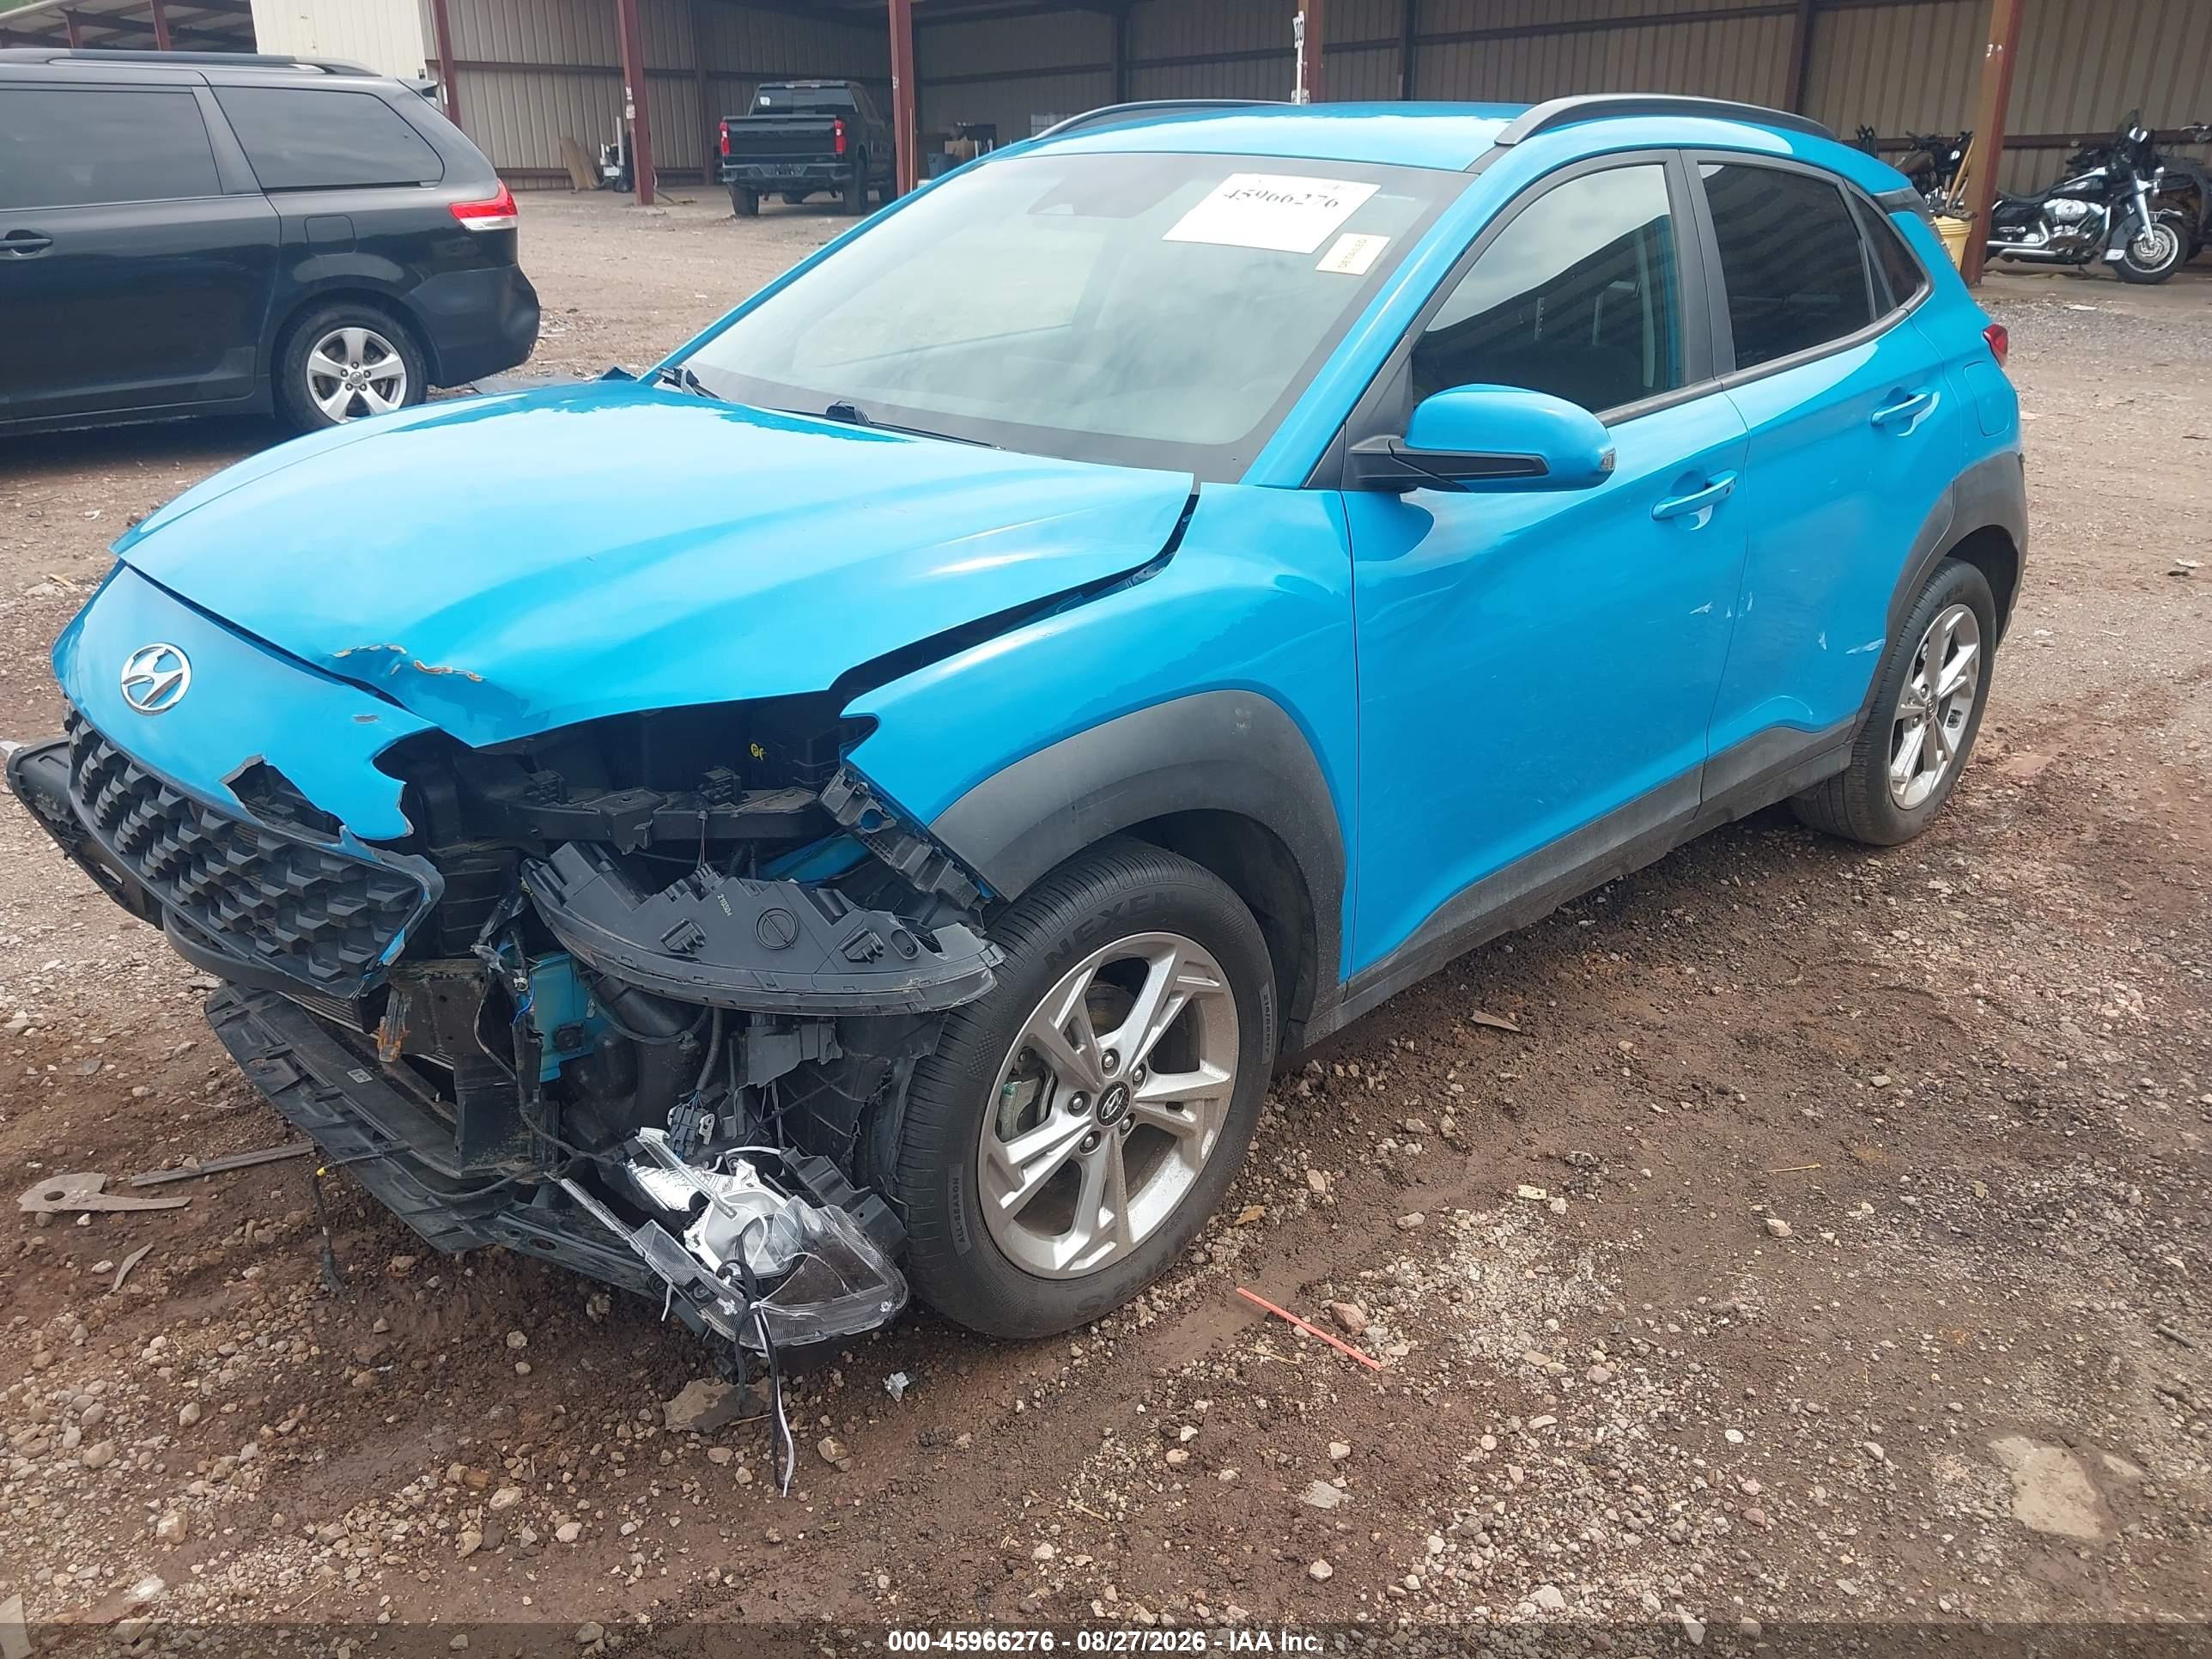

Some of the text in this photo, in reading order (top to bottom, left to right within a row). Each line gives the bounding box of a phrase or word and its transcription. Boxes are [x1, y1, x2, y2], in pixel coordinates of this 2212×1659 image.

[1338, 237, 1368, 270] DETAILED
[1043, 890, 1179, 973] NEXEN
[952, 1176, 966, 1243] ALL-SEASON
